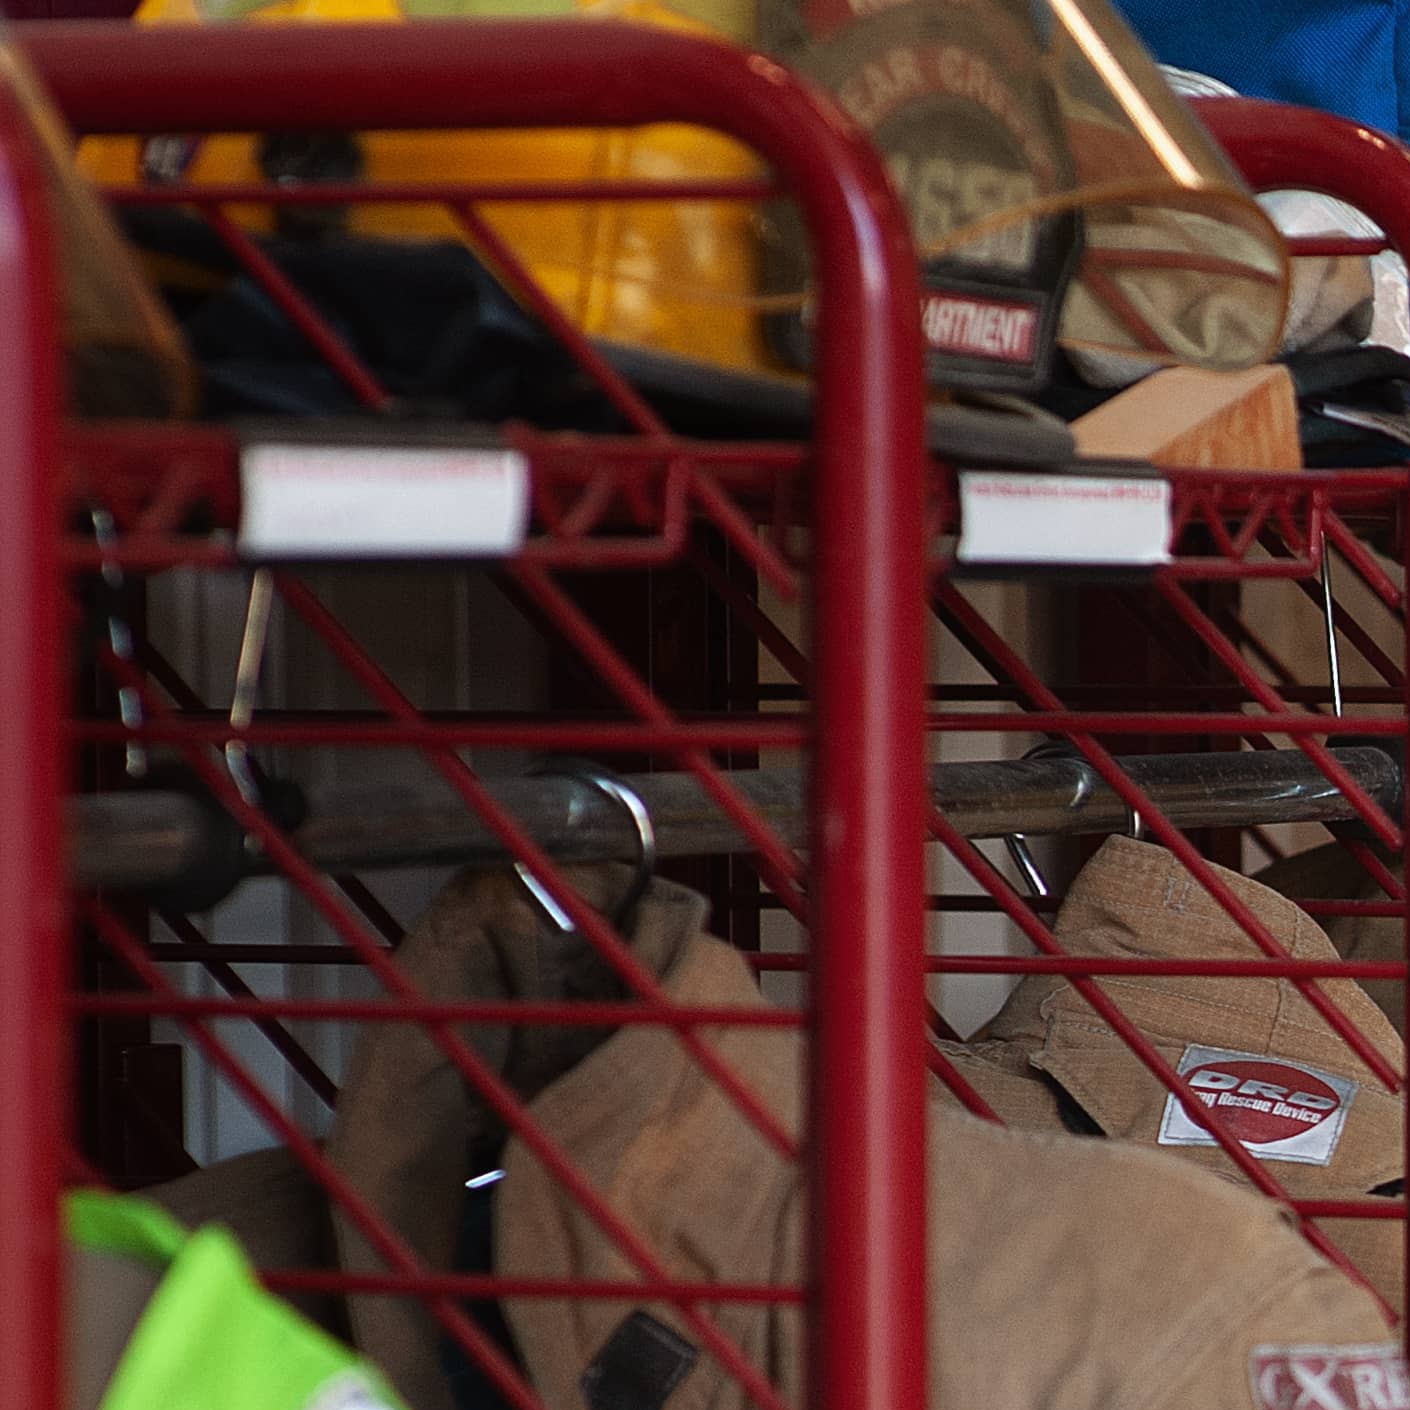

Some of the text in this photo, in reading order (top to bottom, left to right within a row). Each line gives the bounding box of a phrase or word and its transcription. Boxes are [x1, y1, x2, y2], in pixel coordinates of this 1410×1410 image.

[922, 296, 1030, 353] ARTMENT
[1188, 1070, 1337, 1110] DRD
[1218, 1092, 1271, 1113] Rescue
[1272, 1101, 1323, 1125] Device
